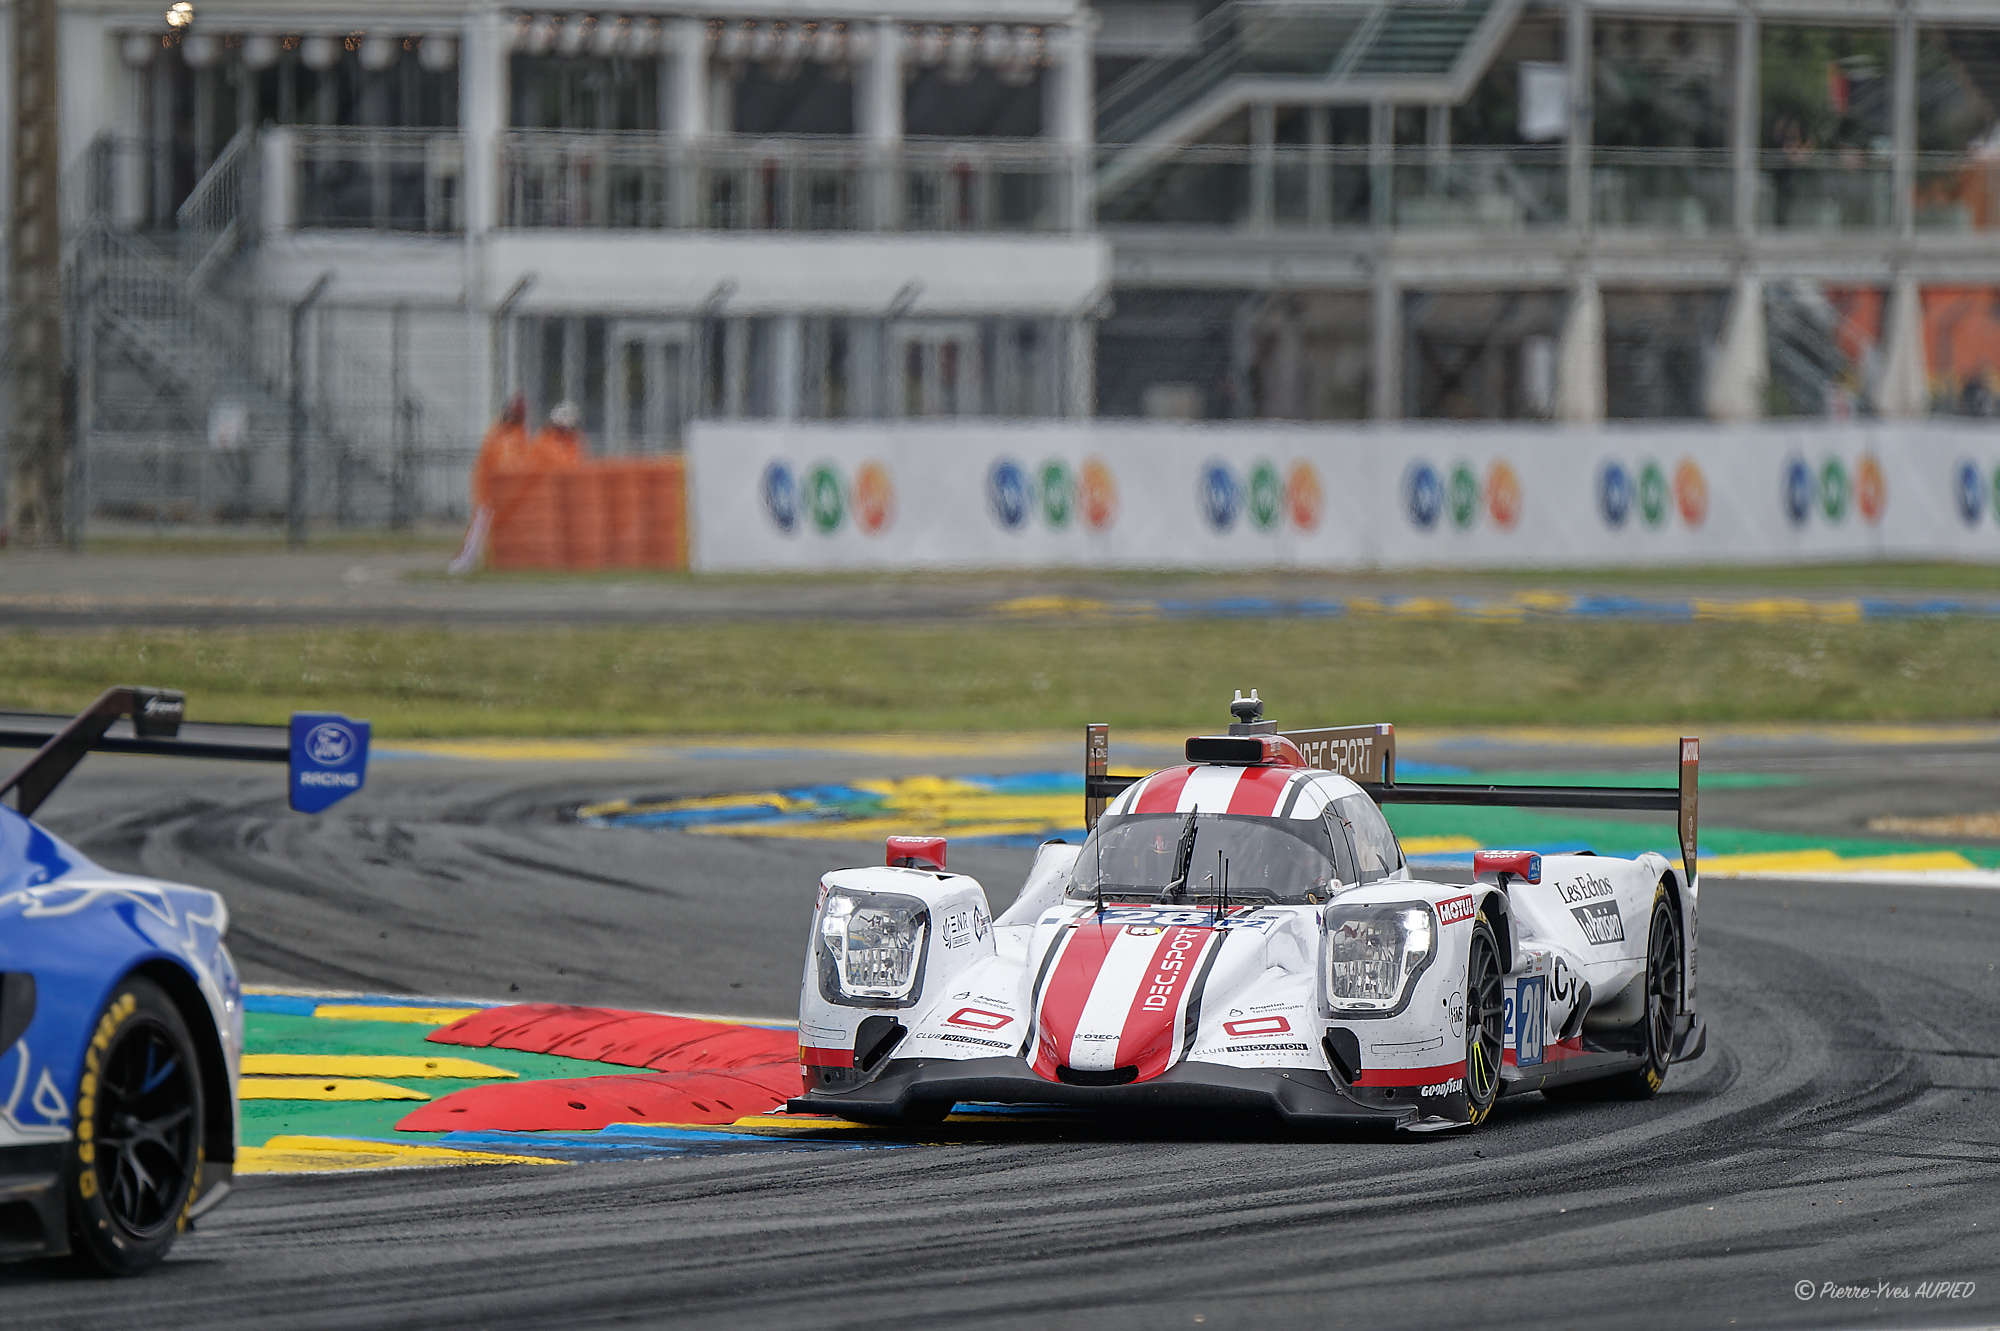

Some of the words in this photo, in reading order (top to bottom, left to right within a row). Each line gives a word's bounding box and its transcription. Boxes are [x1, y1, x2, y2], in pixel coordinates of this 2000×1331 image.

[1330, 737, 1373, 776] SPORT
[301, 771, 359, 788] RACING
[1438, 896, 1475, 922] MOTUL
[1101, 910, 1208, 926] 28
[1521, 983, 1541, 1059] 28
[915, 1032, 942, 1040] CLUB
[943, 1034, 1009, 1049] INNOVATION
[1229, 1043, 1305, 1052] INNOVATION
